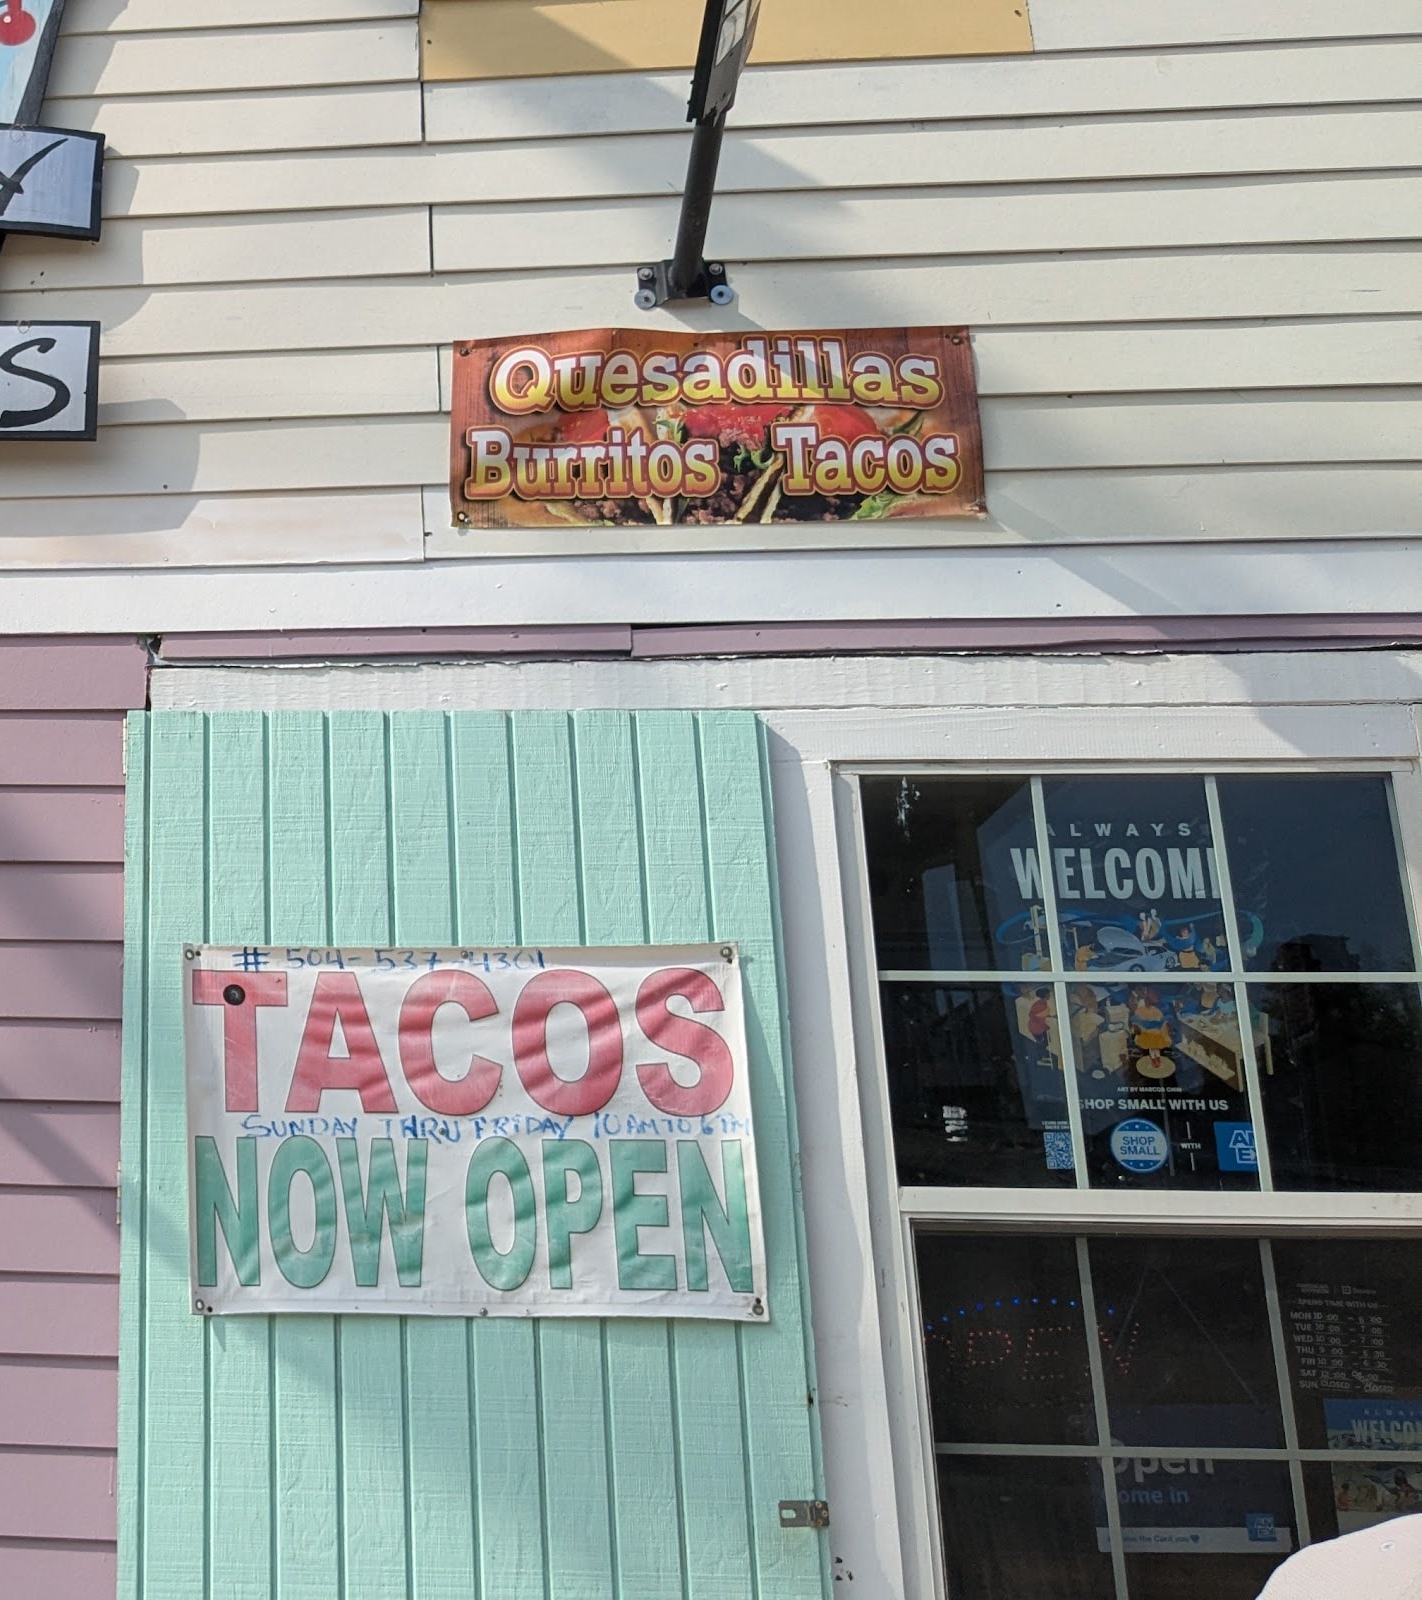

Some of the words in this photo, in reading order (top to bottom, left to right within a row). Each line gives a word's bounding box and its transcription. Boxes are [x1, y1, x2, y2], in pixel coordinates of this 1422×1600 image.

[490, 334, 946, 415] Quesadillas
[464, 424, 721, 501] Burritos
[772, 421, 964, 497] Tacos
[192, 967, 735, 1117] TACOS
[1078, 1099, 1115, 1111] SHOP
[1118, 1099, 1166, 1111] SMALL
[1168, 1099, 1207, 1112] WITH
[1209, 1100, 1229, 1112] US
[241, 1114, 358, 1138] SUNDAY
[378, 1114, 462, 1145] THRU
[1121, 1136, 1155, 1146] SHOP
[1120, 1146, 1161, 1156] SMALL
[194, 1136, 429, 1289] NOW
[465, 1136, 755, 1294] OPEN
[1100, 1487, 1167, 1505] ome
